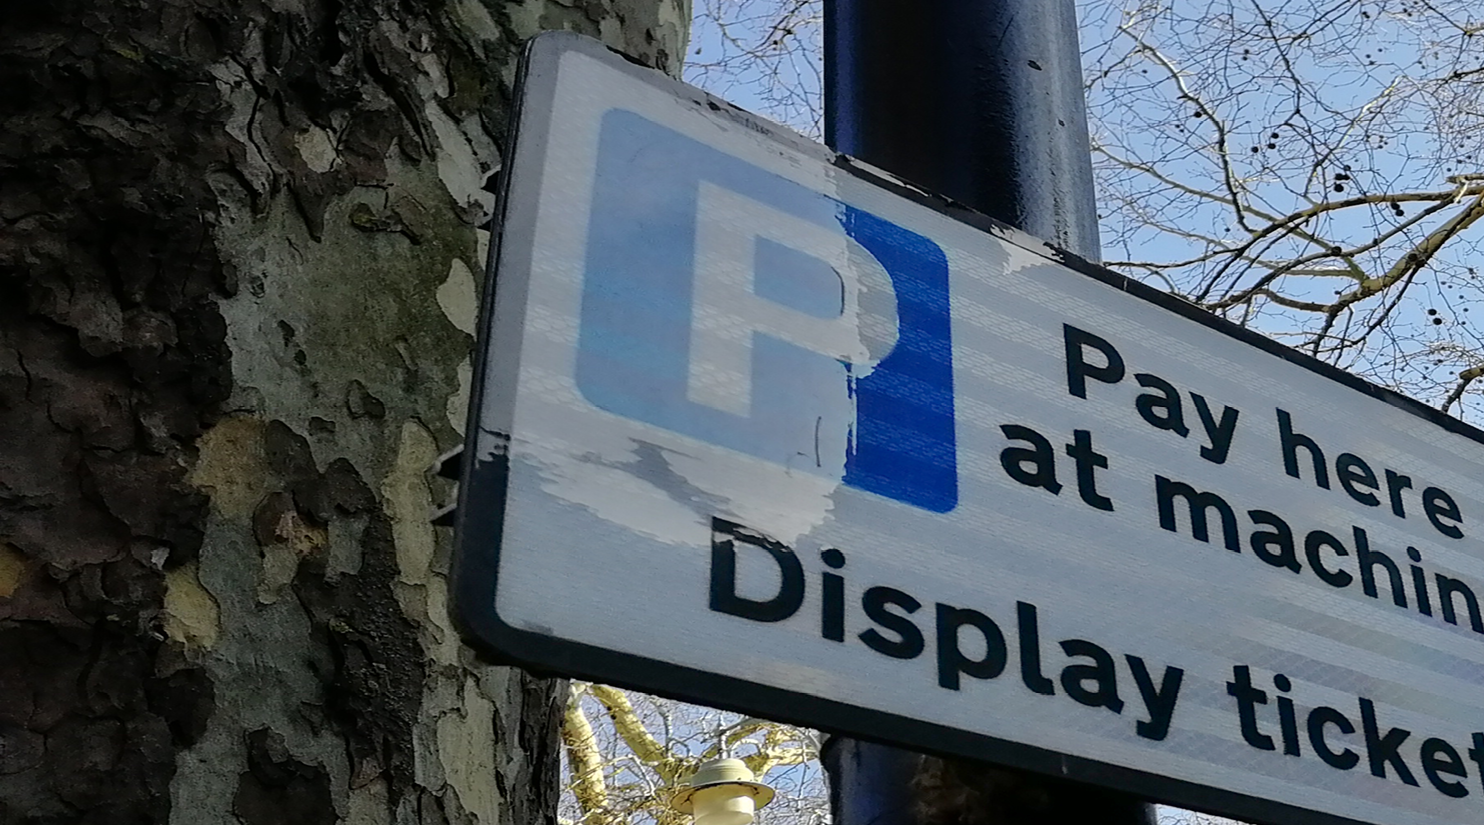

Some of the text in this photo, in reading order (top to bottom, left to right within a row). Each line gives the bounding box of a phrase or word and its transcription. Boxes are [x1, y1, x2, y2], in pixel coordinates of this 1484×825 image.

[687, 180, 900, 418] P
[1000, 424, 1114, 512] at
[1063, 323, 1465, 539] Pay here
[709, 516, 1184, 741] Display
